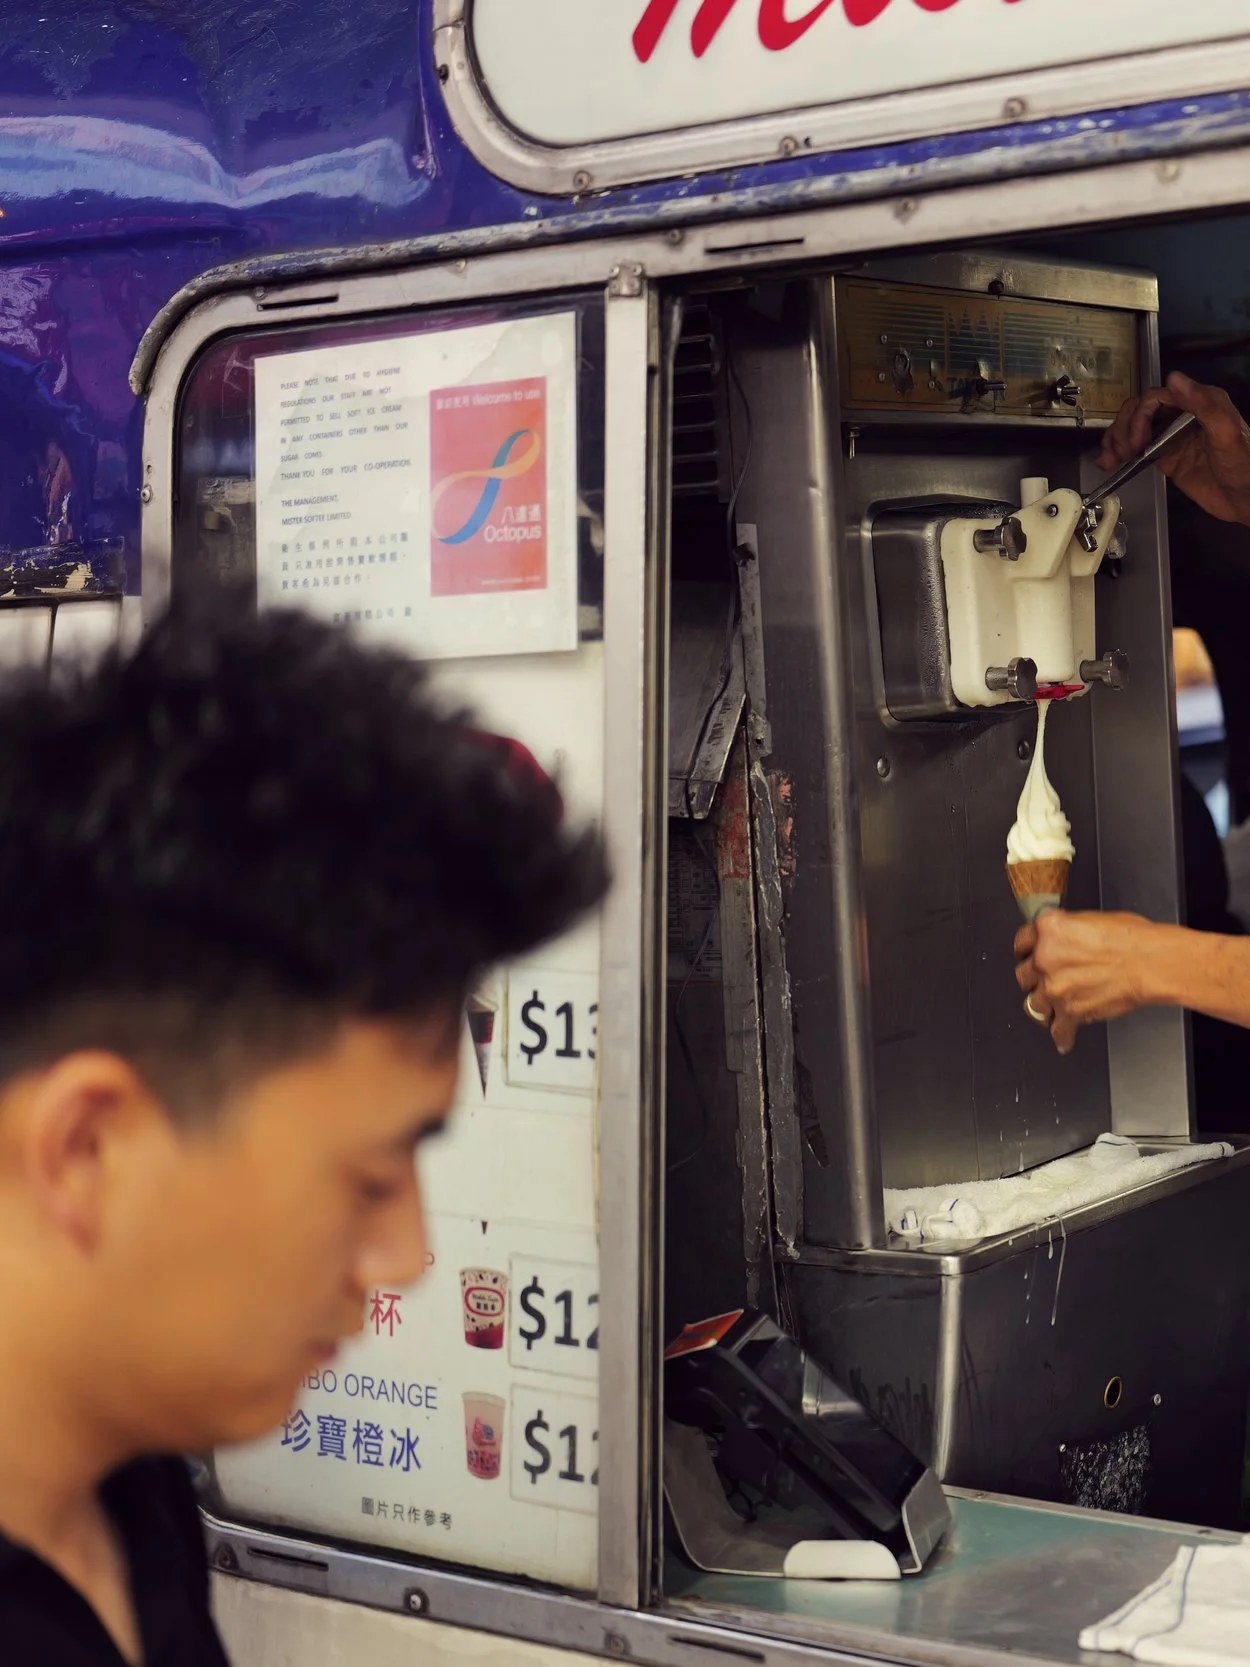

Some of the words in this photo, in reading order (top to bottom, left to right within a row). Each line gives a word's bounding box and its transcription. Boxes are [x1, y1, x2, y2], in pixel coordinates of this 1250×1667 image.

[281, 382, 299, 390] PLEASE
[305, 378, 319, 387] NOTE
[325, 376, 338, 384] THAT
[345, 373, 356, 381] DUE
[281, 397, 316, 408] REGULATIONS
[472, 392, 512, 407] Welcome
[513, 391, 523, 401] to
[525, 389, 541, 400] use
[281, 415, 310, 426] PERMITTED
[316, 414, 323, 422] TO
[330, 412, 341, 420] SELL
[347, 410, 361, 418] SOFT
[367, 407, 375, 415] ICE
[381, 404, 402, 413] CREAM
[292, 435, 303, 443] ANY
[309, 430, 342, 441] CONTAINERS
[349, 427, 367, 436] OTHER
[396, 422, 408, 430] OUR
[281, 454, 298, 462] SUGAR
[281, 471, 300, 480] THANK
[302, 469, 315, 478] YOU
[341, 465, 357, 473] YOUR
[281, 499, 293, 507] THE
[282, 516, 304, 526] MISTER
[327, 512, 351, 521] LIMITED
[502, 504, 541, 524] 八達通
[484, 525, 541, 544] Octopus
[344, 1373, 439, 1410] ORANGE
[280, 1408, 422, 1472] 珍寶橙冰
[361, 1496, 454, 1530] 圖片只作參考
